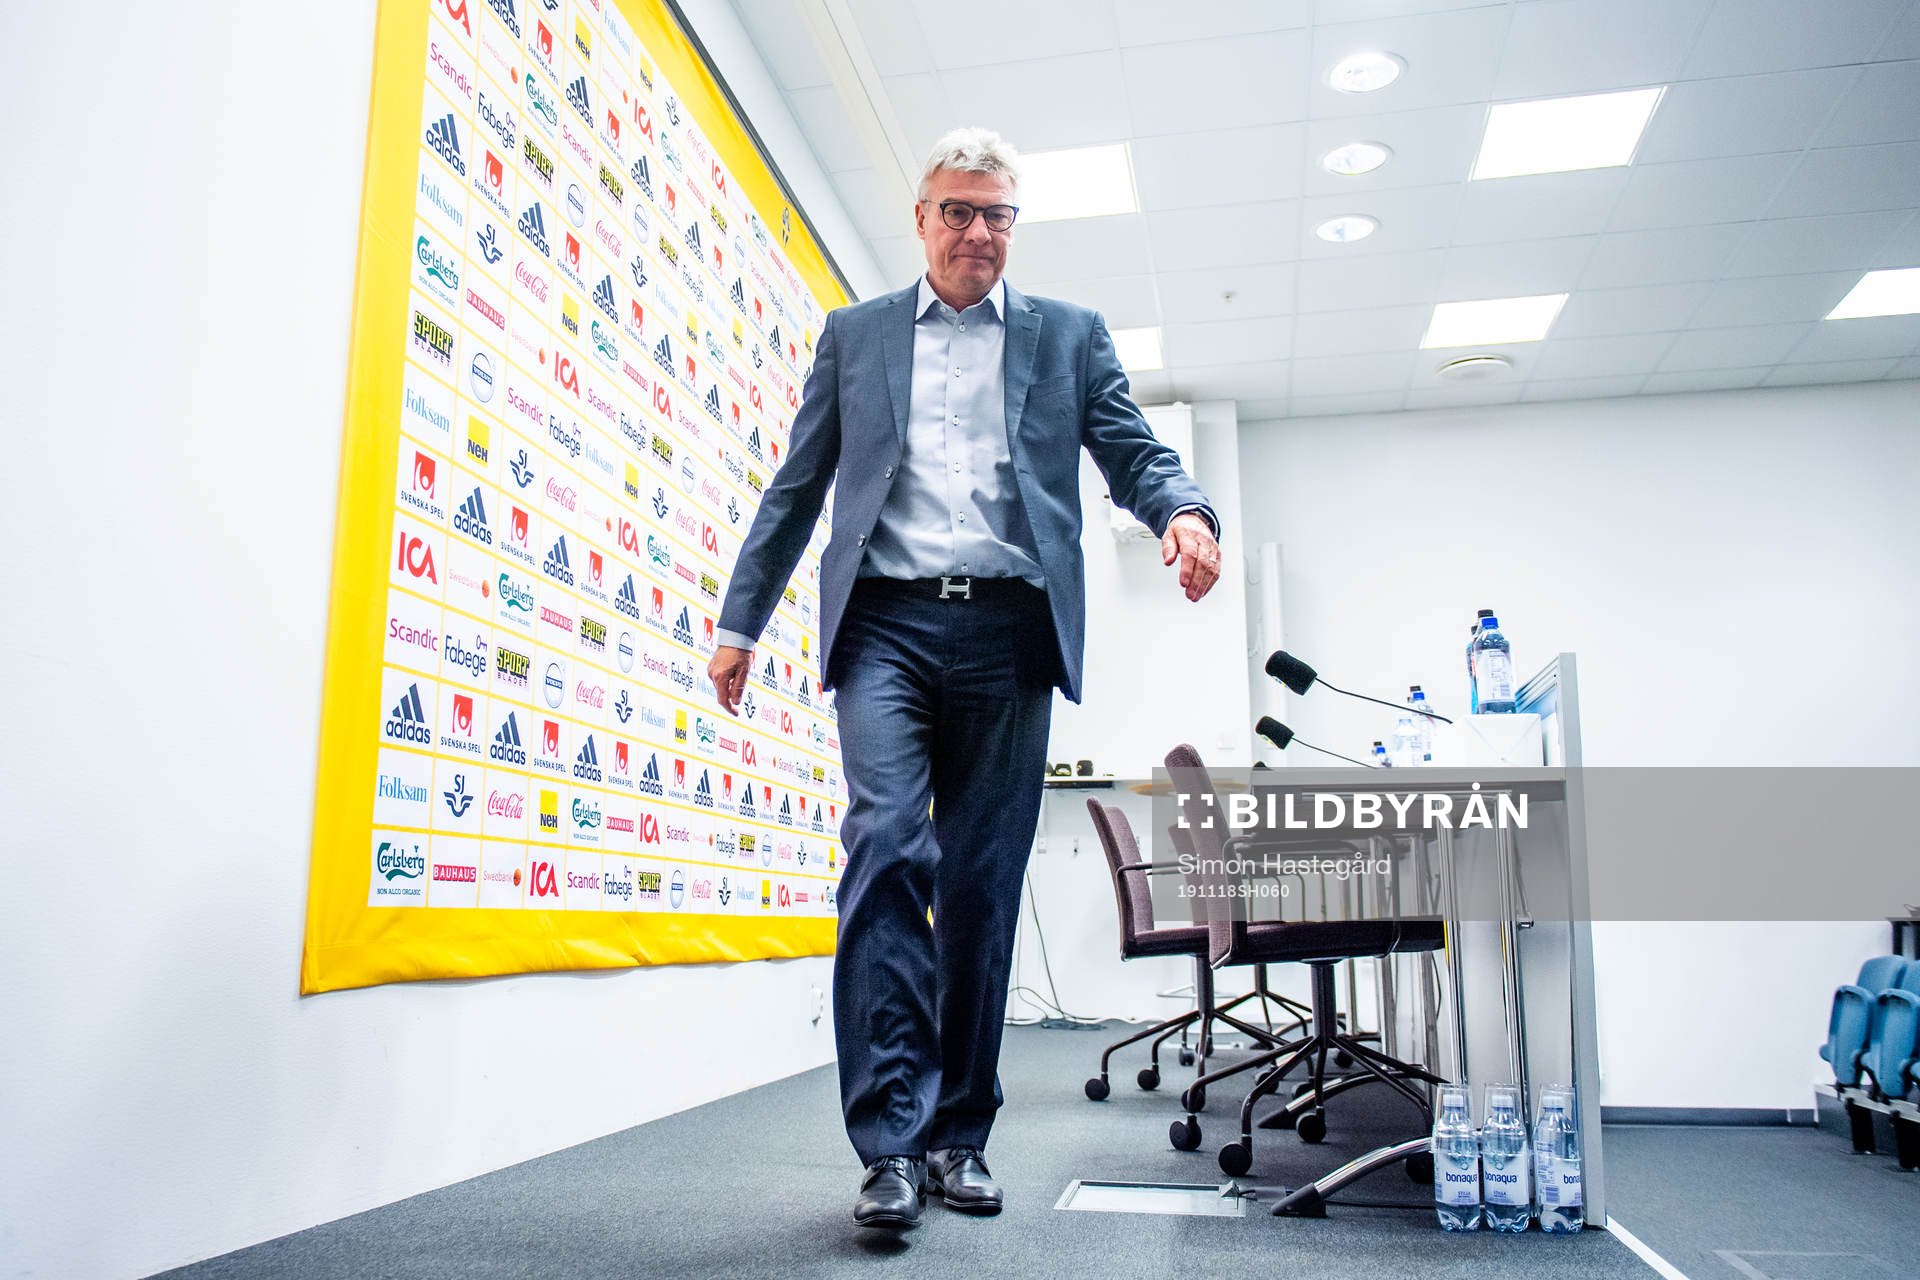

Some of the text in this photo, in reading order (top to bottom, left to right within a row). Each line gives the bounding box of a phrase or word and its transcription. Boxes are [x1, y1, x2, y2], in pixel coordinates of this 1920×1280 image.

[430, 42, 472, 100] Scandic
[525, 73, 557, 126] Carlsberg
[566, 88, 594, 128] adidas
[478, 92, 515, 148] Fabege
[634, 98, 654, 144] ICA
[426, 130, 466, 176] adidas
[524, 136, 554, 182] SPORT
[562, 124, 592, 168] Scandic
[599, 164, 623, 203] SPORT
[630, 168, 654, 202] adidas
[711, 160, 726, 198] ICA
[420, 174, 462, 226] Folksam
[474, 178, 510, 219] SVENSKA SPEL
[485, 223, 496, 245] SJ
[518, 219, 550, 257] adidas
[684, 234, 704, 264] adidas
[417, 236, 458, 290] Carlsberg
[557, 258, 576, 280] SVENSKA
[636, 255, 643, 272] SJ
[465, 288, 505, 330] BAUHAUS
[592, 291, 618, 324] adidas
[414, 311, 453, 358] SPORT
[591, 320, 618, 361] Carlsberg
[414, 337, 450, 366] BLADET
[653, 350, 676, 378] adidas
[554, 352, 580, 398] ICA
[406, 388, 450, 432] Folksam
[508, 387, 543, 426] Scandic
[587, 388, 616, 423] Scandic
[653, 381, 672, 421] ICA
[704, 400, 722, 424] adidas
[749, 381, 763, 414] ICA
[549, 415, 580, 458] Fabege
[620, 412, 646, 451] Fabege
[518, 449, 527, 469] SJ
[400, 490, 444, 520] SVENSKA SPEL
[657, 487, 664, 504] SJ
[454, 514, 492, 544] adidas
[618, 517, 640, 557] ICA
[702, 522, 718, 556] ICA
[398, 532, 437, 584] ICA
[500, 541, 535, 566] SVENSKA SPEL
[543, 560, 574, 586] adidas
[498, 573, 534, 611] Carlsberg
[539, 606, 573, 632] BAUHAUS
[614, 597, 640, 620] adidas
[390, 618, 438, 651] Scandic
[580, 616, 606, 646] SPORT
[672, 628, 694, 647] adidas
[444, 635, 486, 677] Fabege
[496, 647, 530, 679] SPORT
[643, 653, 668, 676] Scandic
[497, 672, 528, 687] BLADET
[670, 662, 693, 692] Fabege
[620, 689, 628, 706] SJ
[386, 719, 430, 744] adidas
[780, 710, 793, 736] ICA
[440, 736, 481, 754] SVENSKA SPEL
[490, 742, 526, 765] adidas
[742, 740, 756, 766] ICA
[533, 758, 566, 773] SVENSKA SPEL
[573, 762, 602, 782] adidas
[378, 775, 427, 802] Folksam
[454, 774, 465, 795] SJ
[639, 778, 663, 796] adidas
[572, 798, 601, 826] Carlsberg
[694, 792, 713, 808] adidas
[606, 816, 634, 832] BAUHAUS
[639, 813, 660, 844] ICA
[666, 825, 690, 842] Scandic
[376, 842, 424, 876] Carlsberg
[432, 864, 476, 883] BAUHAUS
[483, 870, 512, 882] Swedbank
[530, 861, 558, 897] ICA
[567, 871, 600, 890] Scandic
[604, 872, 632, 901] Fabege
[638, 871, 660, 892] SPORT
[722, 876, 728, 890] SJ
[777, 884, 791, 908] ICA
[1446, 1172, 1477, 1184] bonaqua
[1485, 1171, 1517, 1184] bonaqua
